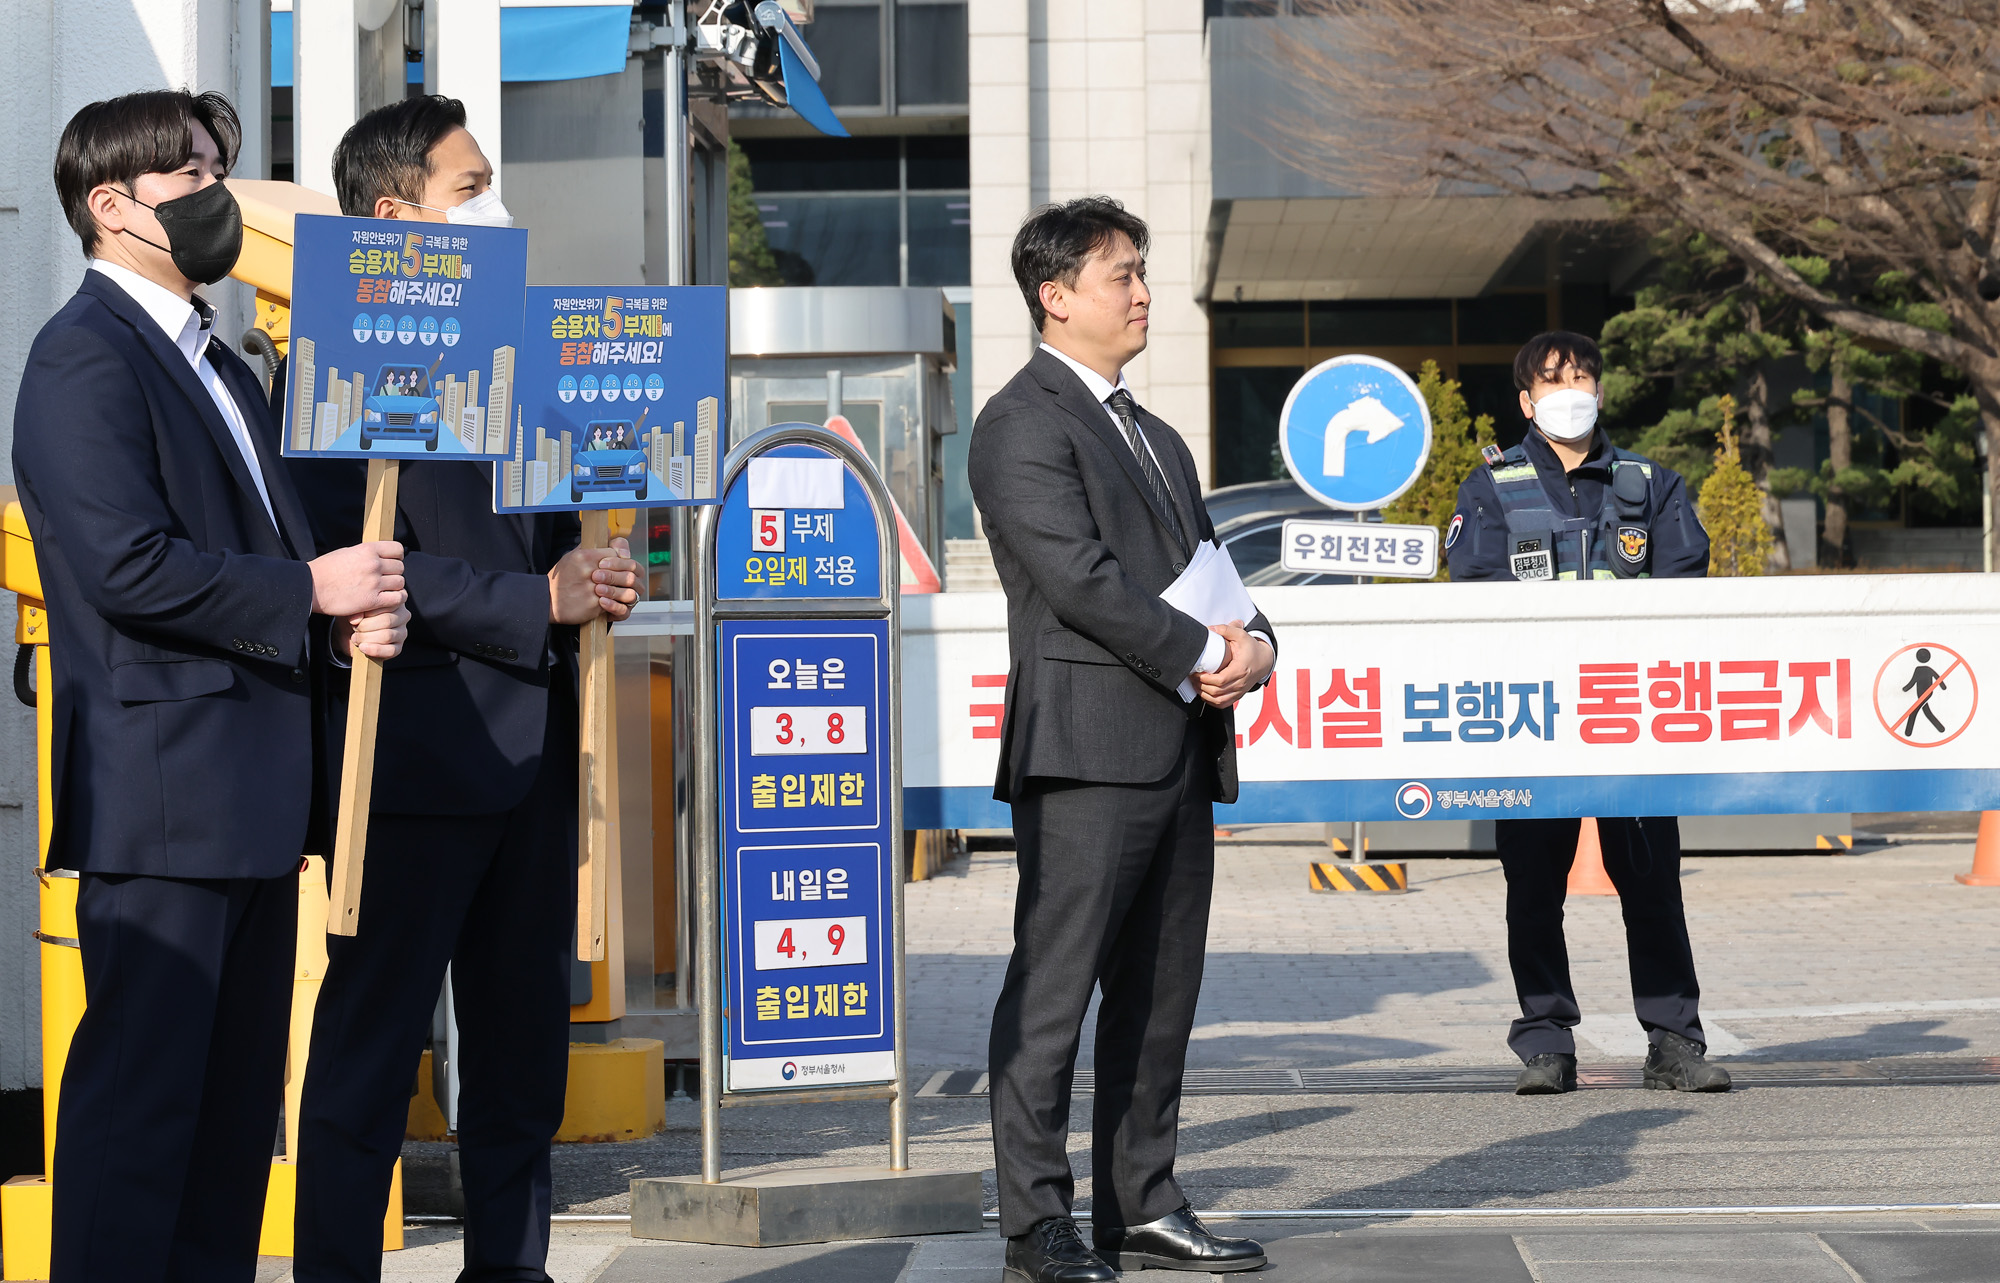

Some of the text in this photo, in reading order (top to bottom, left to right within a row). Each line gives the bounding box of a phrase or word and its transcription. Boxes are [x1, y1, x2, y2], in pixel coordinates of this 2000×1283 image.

[352, 231, 468, 250] 자원안보위기 극복을 위한
[349, 249, 399, 275] 승용차
[356, 278, 463, 307] 동참해주세요!
[553, 298, 668, 311] 자원안보위기 극복을 위한
[403, 333, 410, 342] 수
[447, 335, 454, 344] 금
[551, 314, 601, 339] 승용차
[560, 341, 664, 366] 동참해주세요!
[608, 390, 614, 399] 수
[651, 390, 657, 399] 금
[760, 513, 834, 546] 5 부제
[1294, 533, 1424, 565] 우회전전용
[1515, 555, 1547, 570] 정부청사
[744, 556, 857, 586] 요일제 적용
[1515, 567, 1549, 579] POLICE
[768, 657, 846, 690] 오늘은
[1403, 680, 1560, 743] 보행자
[1577, 658, 1852, 744] 통행금지
[827, 713, 845, 744] 8
[751, 772, 865, 809] 출입제한
[1436, 789, 1532, 809] 정부서울청사
[771, 868, 849, 901] 내일은
[828, 924, 845, 955] 9
[756, 982, 869, 1021] 출입제한
[801, 1064, 845, 1076] 정부서울청사
